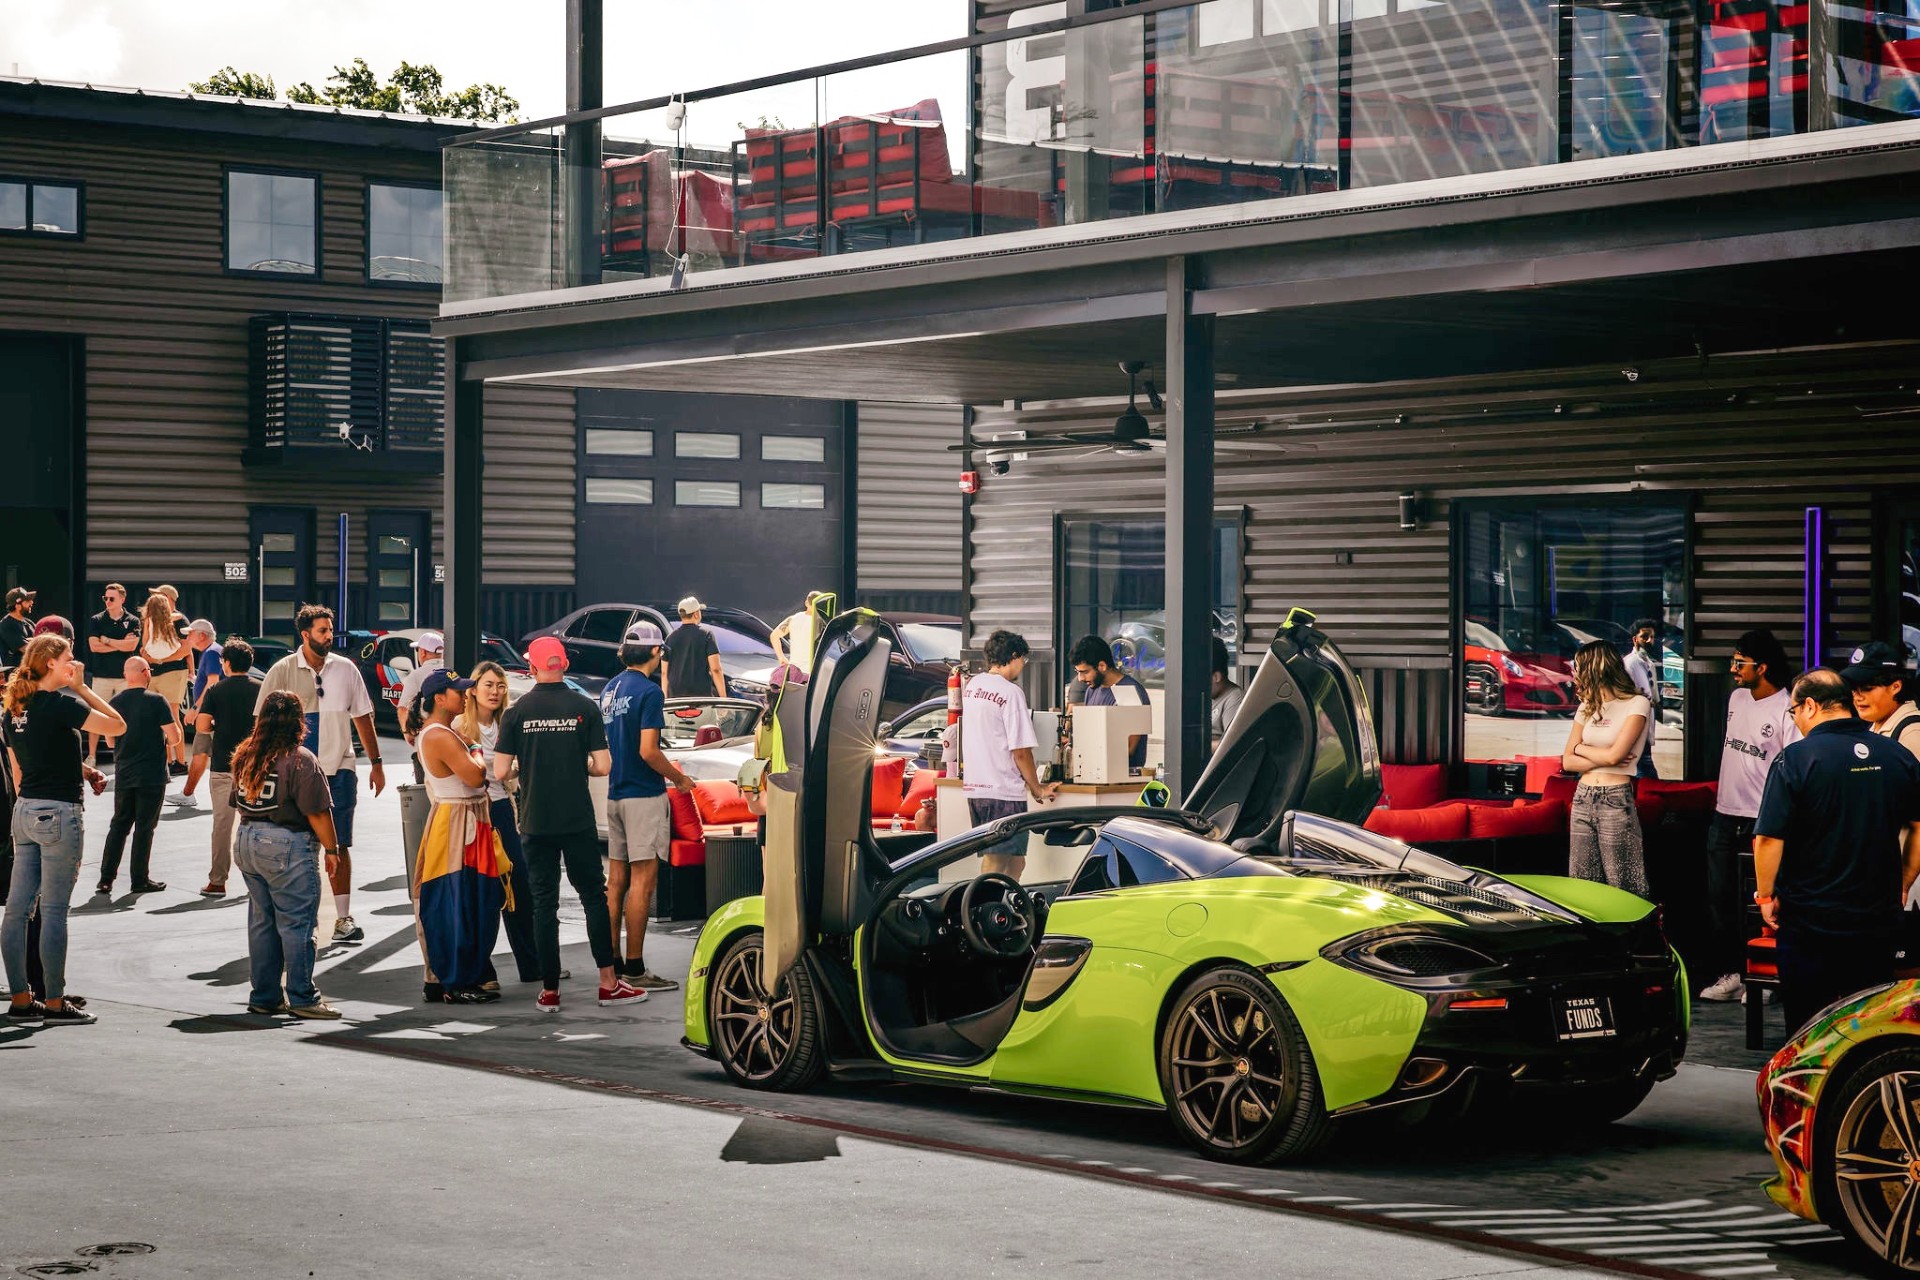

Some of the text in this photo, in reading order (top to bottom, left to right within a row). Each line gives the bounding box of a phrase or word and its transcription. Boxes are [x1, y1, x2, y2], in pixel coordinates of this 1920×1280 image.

[225, 567, 247, 576] 502
[382, 690, 402, 698] MART
[1566, 998, 1595, 1007] TEXAS
[1566, 1008, 1603, 1031] FUNDS
